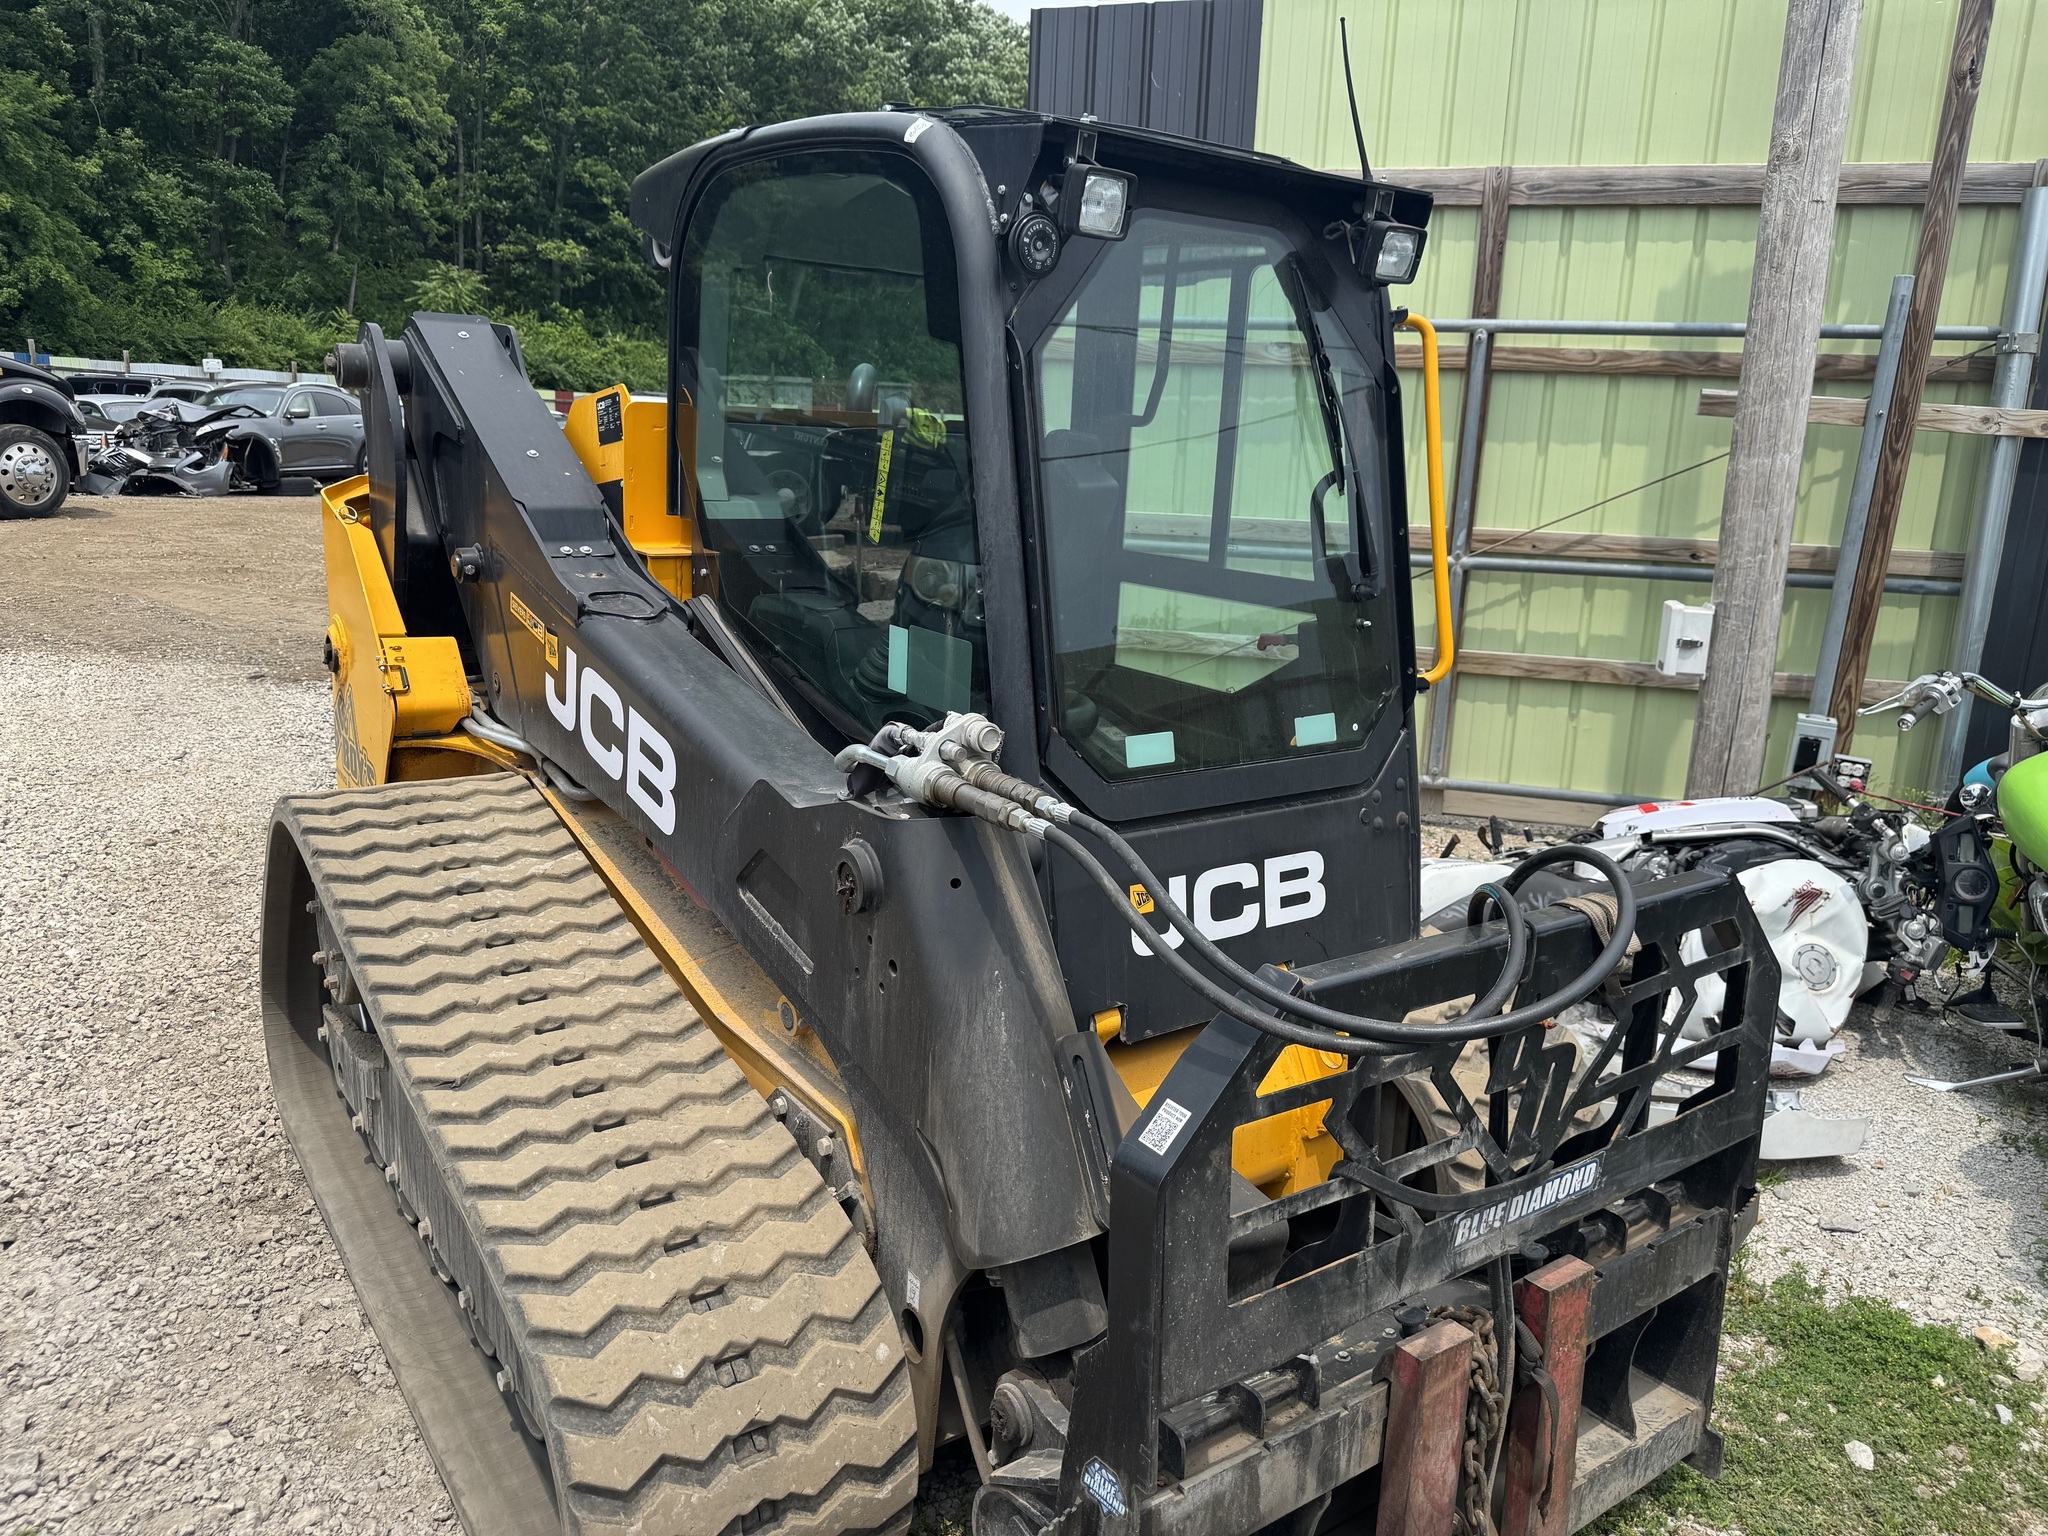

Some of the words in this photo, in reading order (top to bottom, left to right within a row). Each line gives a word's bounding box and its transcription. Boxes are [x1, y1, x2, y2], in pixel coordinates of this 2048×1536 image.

[545, 645, 677, 836] JCB
[1131, 850, 1327, 957] JCB
[1135, 892, 1152, 908] JCB
[1783, 879, 1815, 908] HONDA
[1454, 1201, 1507, 1247] BLUE
[1507, 1162, 1597, 1223] DIAMOND
[1084, 1473, 1126, 1516] DIAMOND
[1094, 1471, 1117, 1497] BLUE
